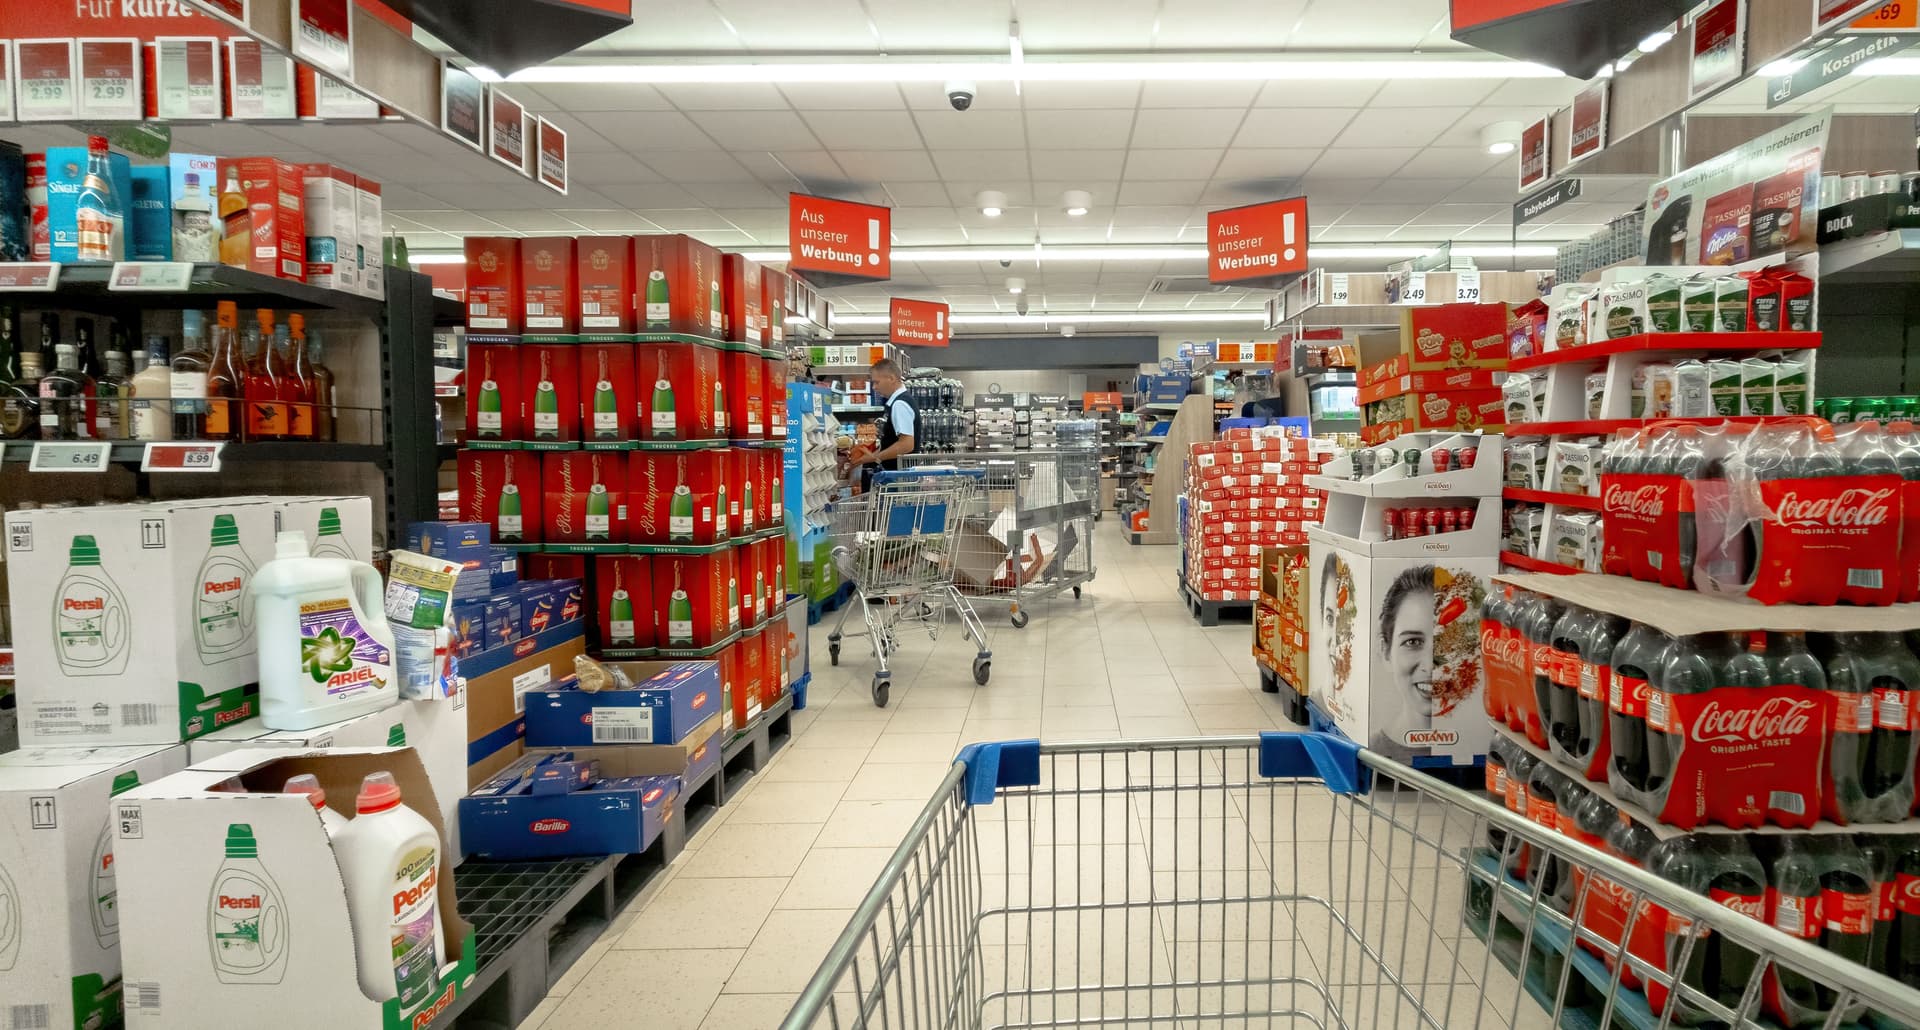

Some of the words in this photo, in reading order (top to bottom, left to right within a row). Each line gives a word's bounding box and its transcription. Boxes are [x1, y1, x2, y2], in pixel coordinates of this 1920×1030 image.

[1872, 3, 1901, 20] .69
[31, 87, 62, 98] 2.99
[93, 87, 125, 99] 2.99
[1765, 119, 1825, 157] probieren!
[190, 159, 217, 170] GORD
[49, 181, 80, 194] SINGLE
[1524, 192, 1560, 217] Babybedarf
[1763, 187, 1802, 207] TASSIMO
[800, 208, 825, 225] Aus
[1714, 204, 1752, 224] TASSIMO
[1217, 224, 1240, 237] Aus
[1826, 214, 1854, 233] BOCK
[54, 230, 66, 241] 12
[800, 228, 849, 244] unserer
[1707, 231, 1738, 255] Milka
[1217, 235, 1263, 253] unserer
[800, 244, 863, 267] Werbung
[1218, 251, 1278, 271] Werbung
[1333, 291, 1348, 300] 1.99
[1404, 288, 1425, 299] 2.49
[1458, 288, 1479, 299] 3.79
[897, 307, 912, 317] Aus
[897, 316, 926, 328] unserer
[897, 329, 934, 342] Werbung
[72, 453, 99, 464] 6.49
[187, 454, 210, 464] 8.99
[1775, 488, 1896, 527] Coca-Cola
[12, 525, 30, 534] MAX
[13, 536, 21, 547] 5
[204, 576, 241, 595] Persil
[64, 597, 104, 611] Persil
[326, 667, 377, 688] ARIEL
[214, 702, 252, 727] Persil
[1691, 697, 1818, 743] Coca-Cola
[1409, 729, 1454, 743] KOTÁNYI
[1710, 743, 1760, 755] ORIGINAL
[1761, 738, 1792, 748] TASTE
[120, 809, 140, 820] MAX
[122, 821, 131, 834] 5
[534, 821, 570, 833] Barilla
[396, 862, 415, 881] 100
[393, 865, 437, 917] Persil
[218, 894, 261, 909] Persil
[411, 981, 457, 1030] Persil
